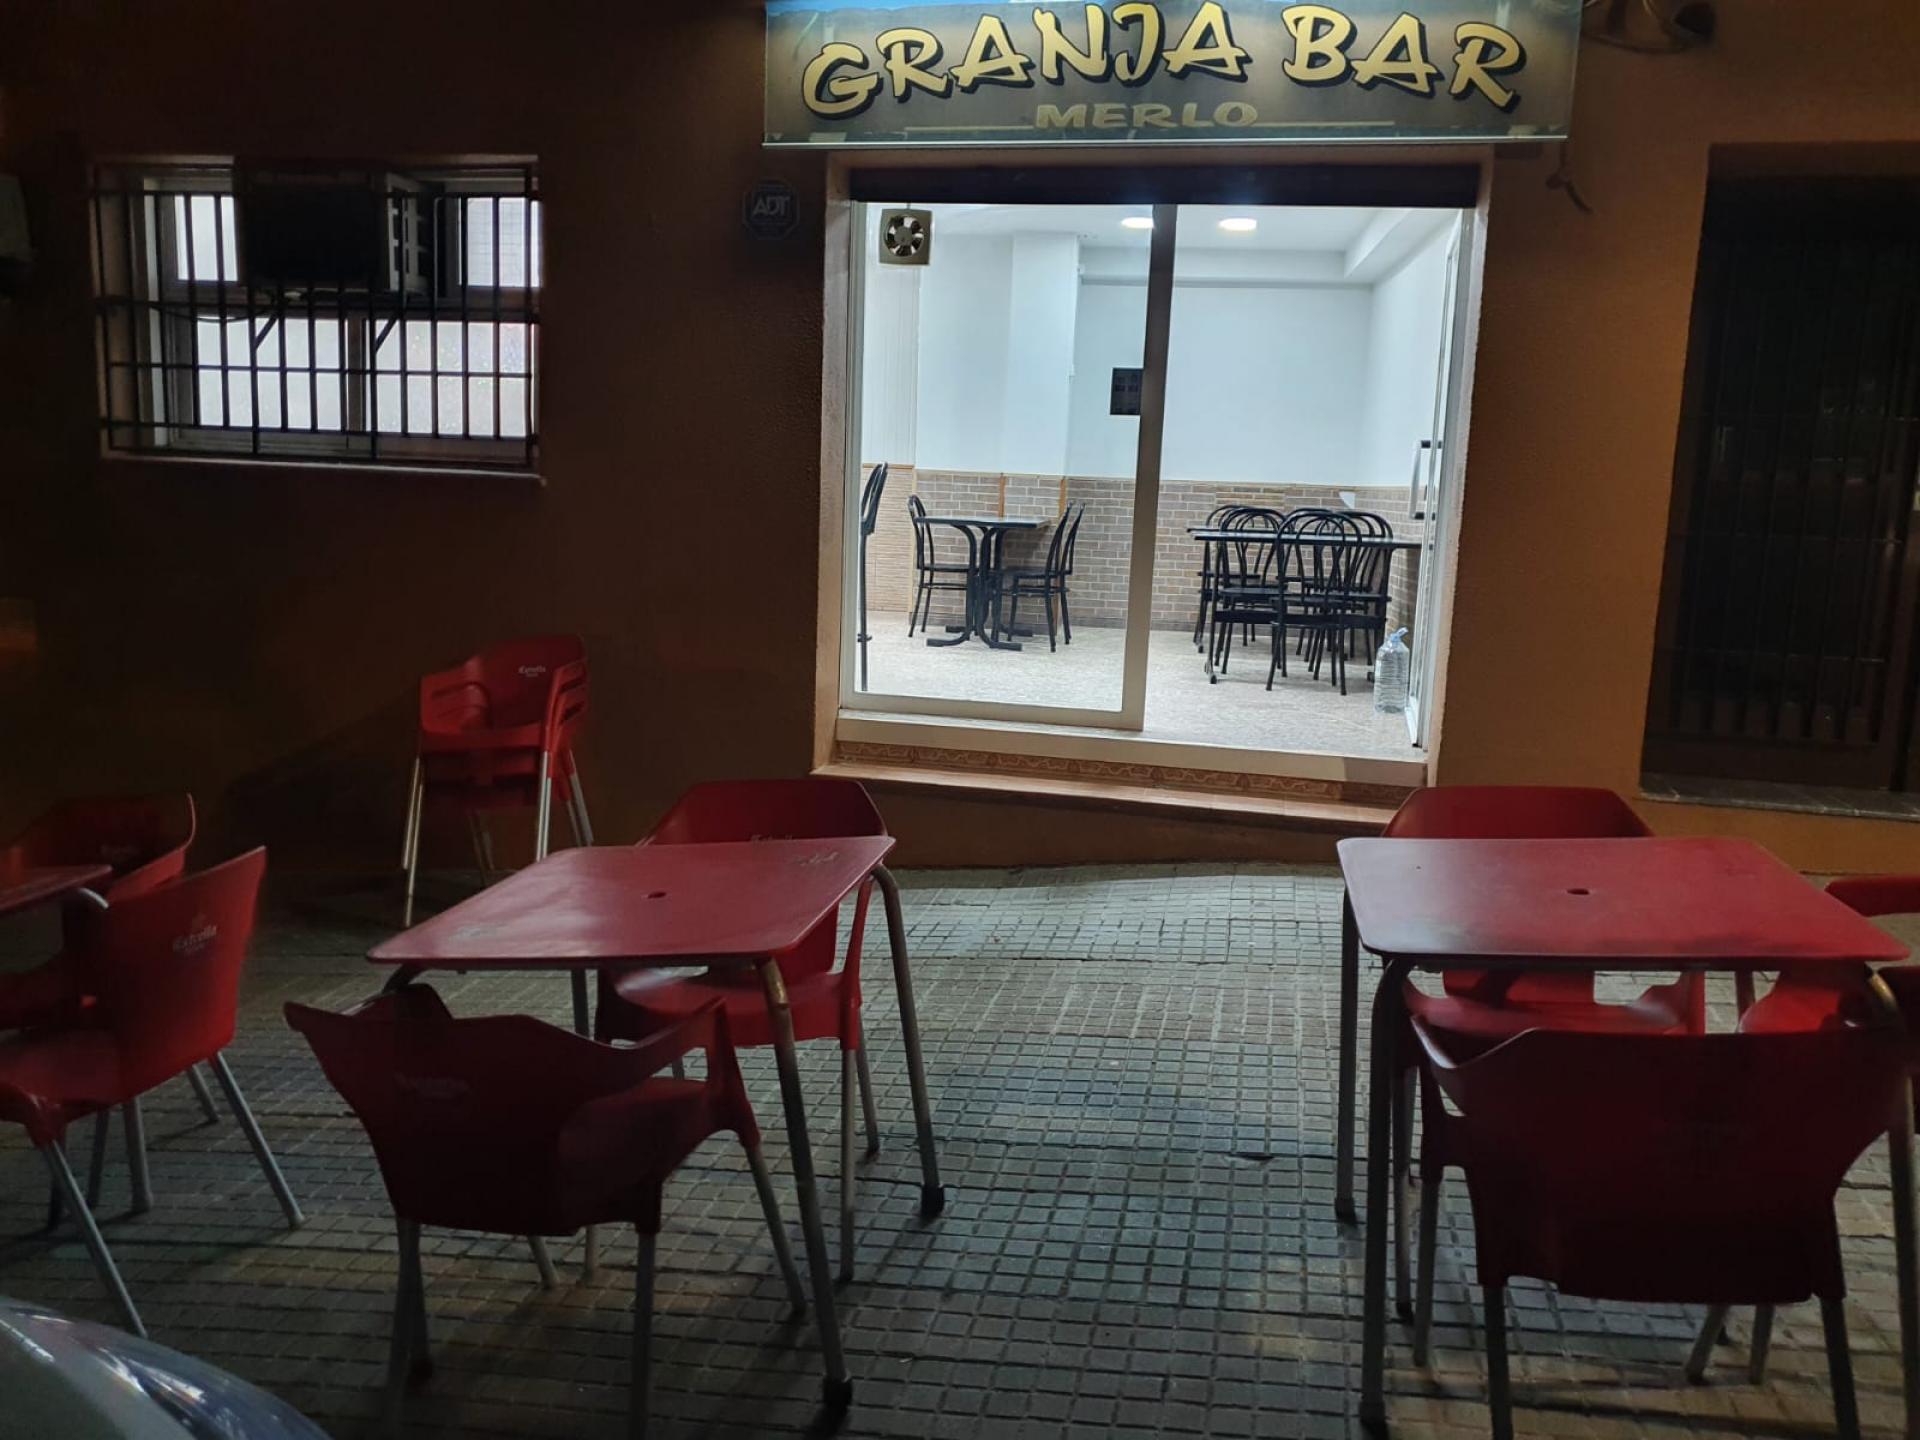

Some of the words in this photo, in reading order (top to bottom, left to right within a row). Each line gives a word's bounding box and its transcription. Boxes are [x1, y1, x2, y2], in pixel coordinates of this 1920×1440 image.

[802, 2, 1248, 117] GRANJA
[1281, 5, 1526, 109] BAR
[1034, 102, 1259, 129] MERLO
[752, 195, 791, 216] ADT
